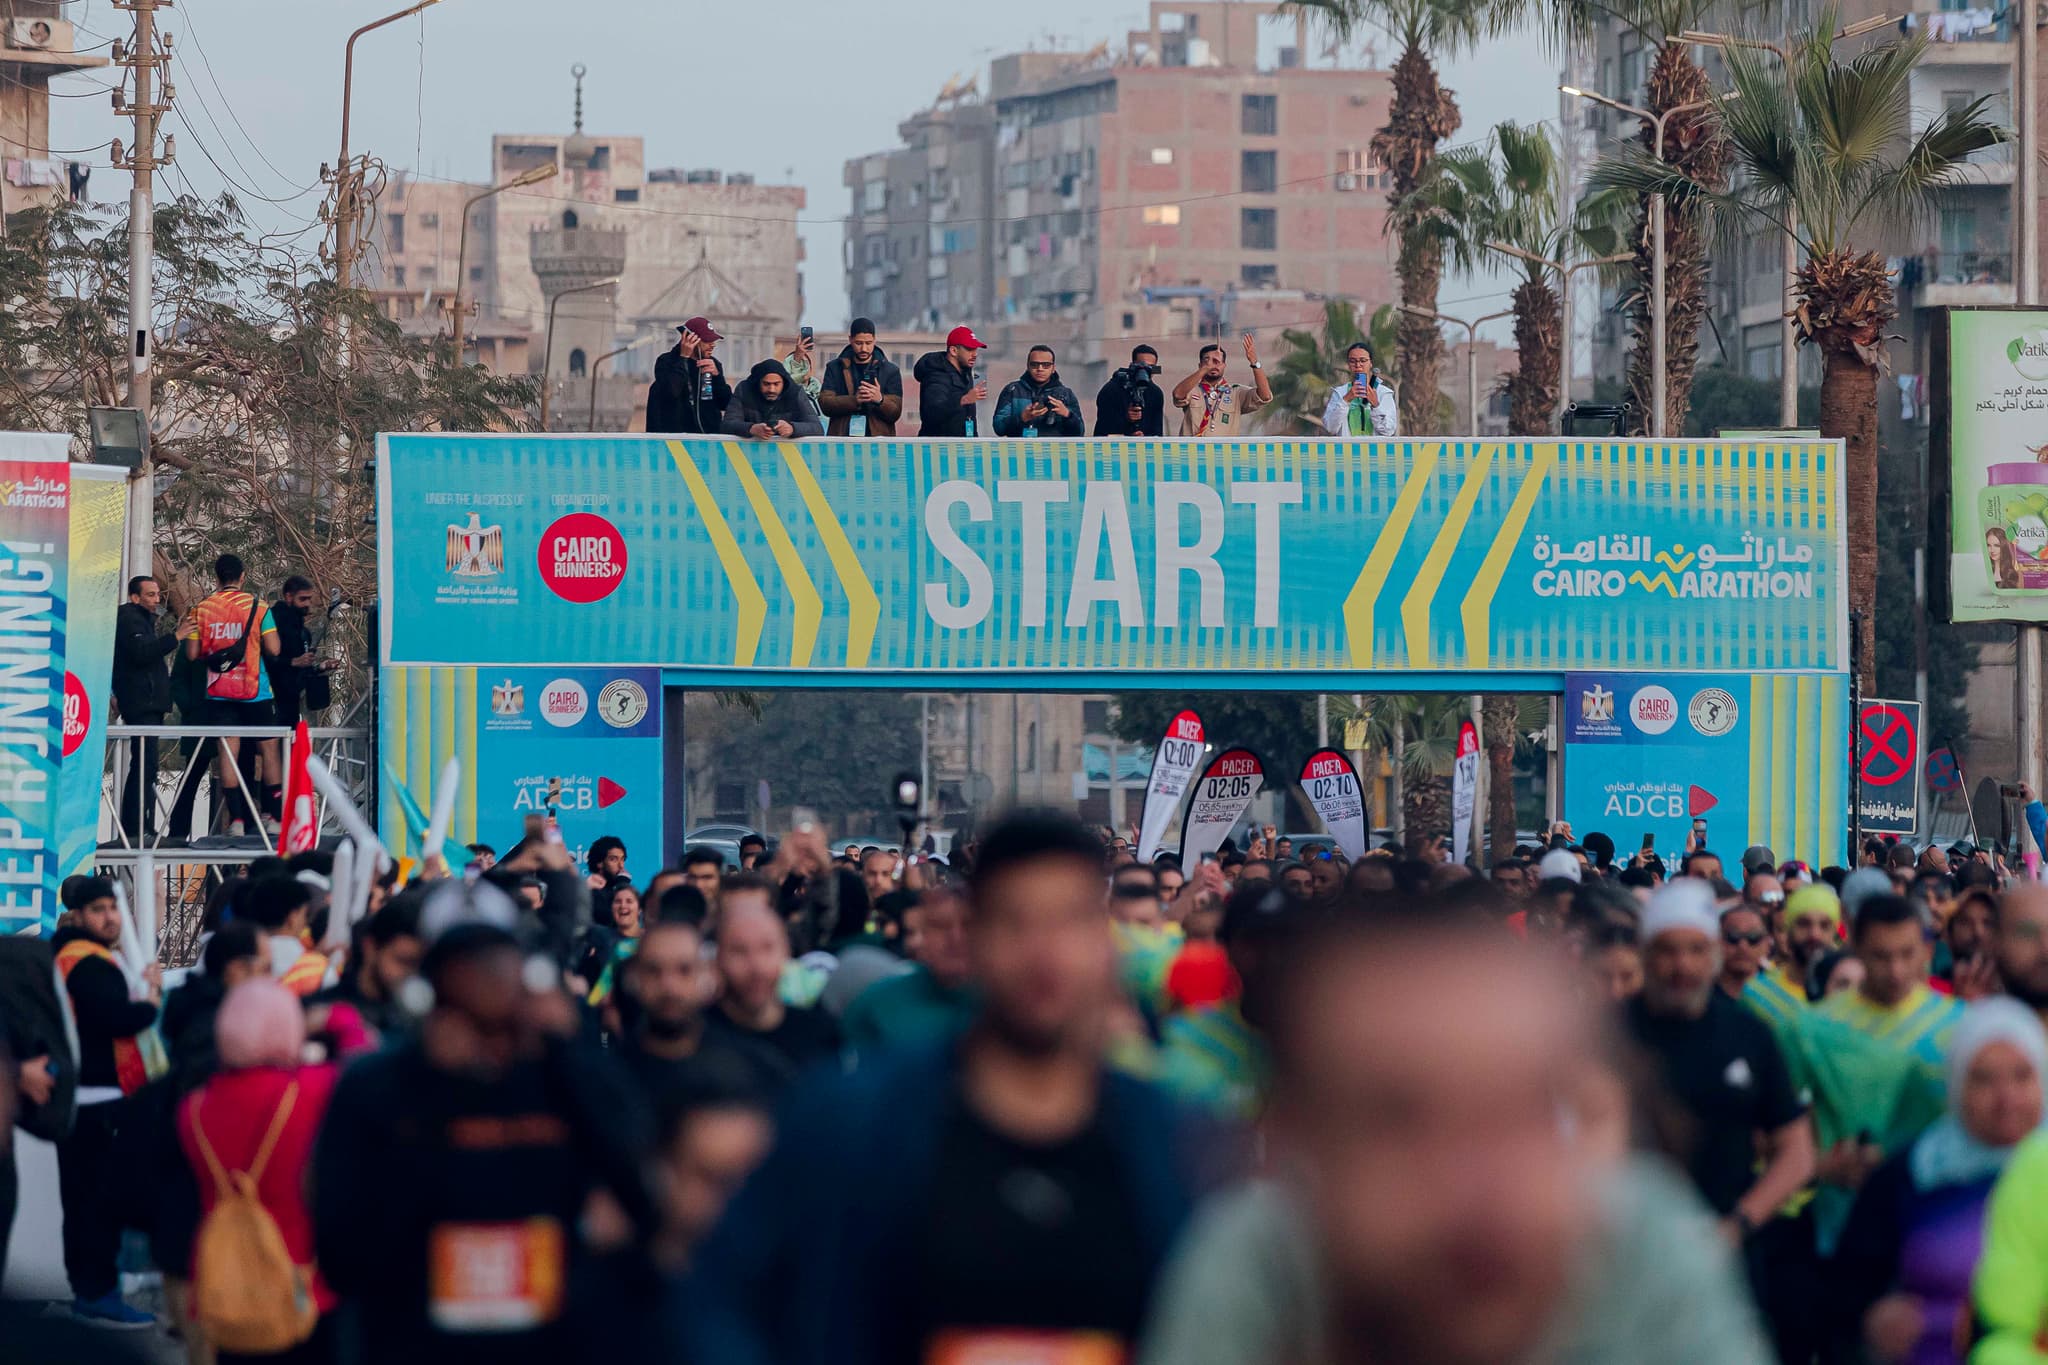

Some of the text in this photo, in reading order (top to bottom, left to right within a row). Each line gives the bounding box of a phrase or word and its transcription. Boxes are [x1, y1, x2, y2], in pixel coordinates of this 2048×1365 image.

[2003, 385, 2023, 398] كريم
[2012, 526, 2045, 538] Vatika
[554, 536, 611, 562] CAIRO
[924, 480, 1303, 629] START
[1533, 530, 1813, 573] ماراثون القاهرة
[554, 562, 611, 578] RUNNERS
[1533, 570, 1813, 598] CAIRO MARATHON
[209, 622, 242, 640] TEAM
[549, 691, 579, 706] CAIRO
[1639, 698, 1669, 713] CAIRO
[548, 706, 579, 714] RUNNERS
[1638, 712, 1669, 721] RUNNERS
[1222, 759, 1254, 775] PACER
[1312, 759, 1342, 777] PACER
[1207, 776, 1250, 799] 02:05
[1314, 775, 1353, 799] 02:10
[1604, 781, 1635, 793] التجاري
[1668, 783, 1683, 793] بنك
[513, 787, 593, 810] ADCB
[1604, 794, 1684, 817] ADCB
